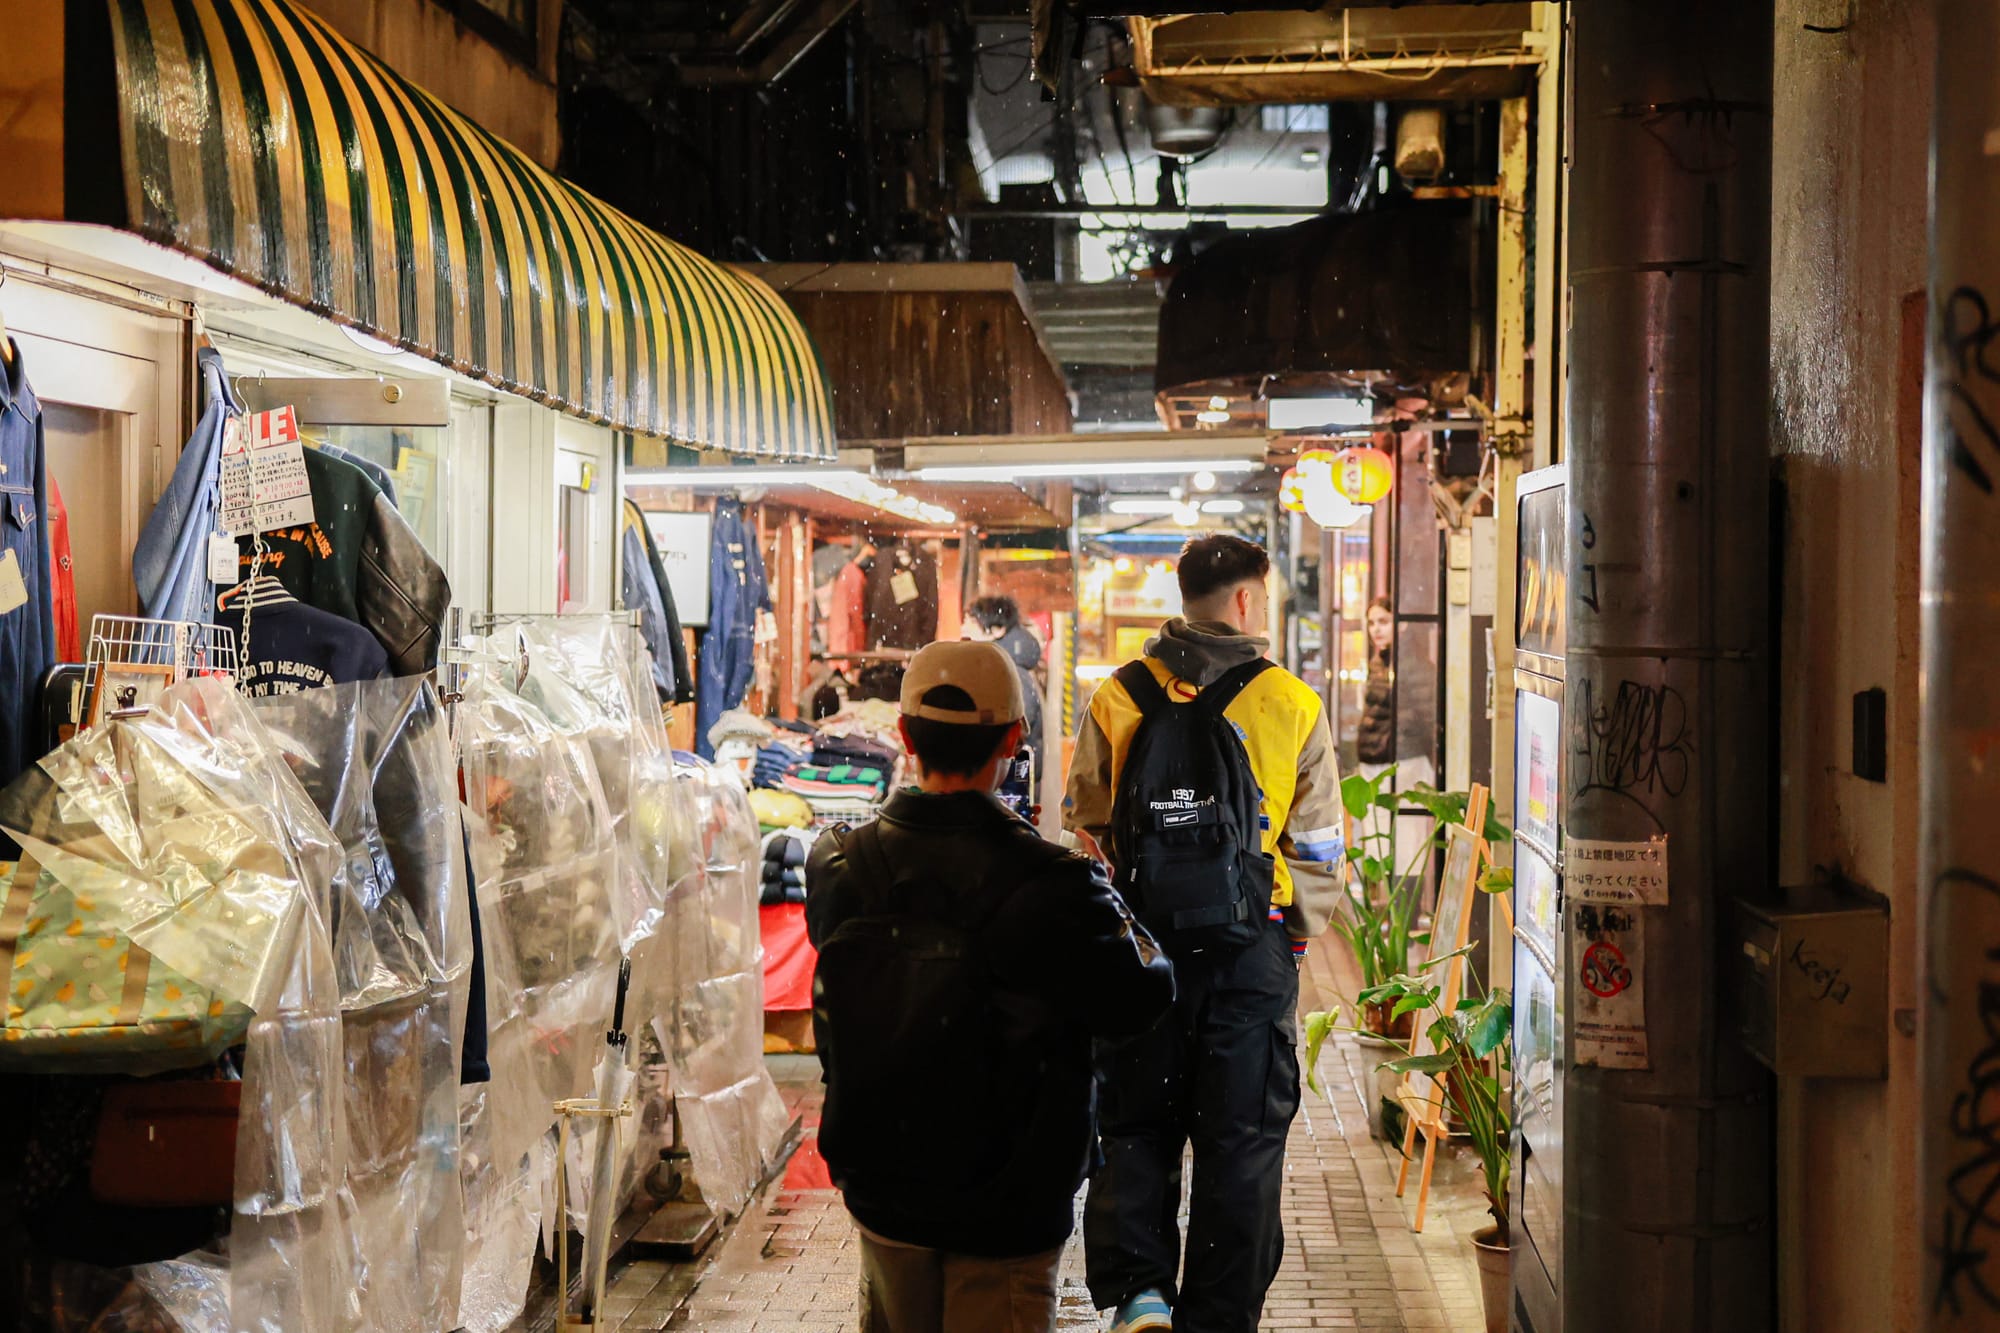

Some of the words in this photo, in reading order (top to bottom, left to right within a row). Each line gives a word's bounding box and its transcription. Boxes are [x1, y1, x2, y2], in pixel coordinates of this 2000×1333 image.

[224, 406, 288, 454] ALE
[259, 660, 274, 675] TO
[277, 660, 324, 682] HEAVEN
[1171, 788, 1195, 801] 1997
[1150, 801, 1184, 810] FOOTBALL
